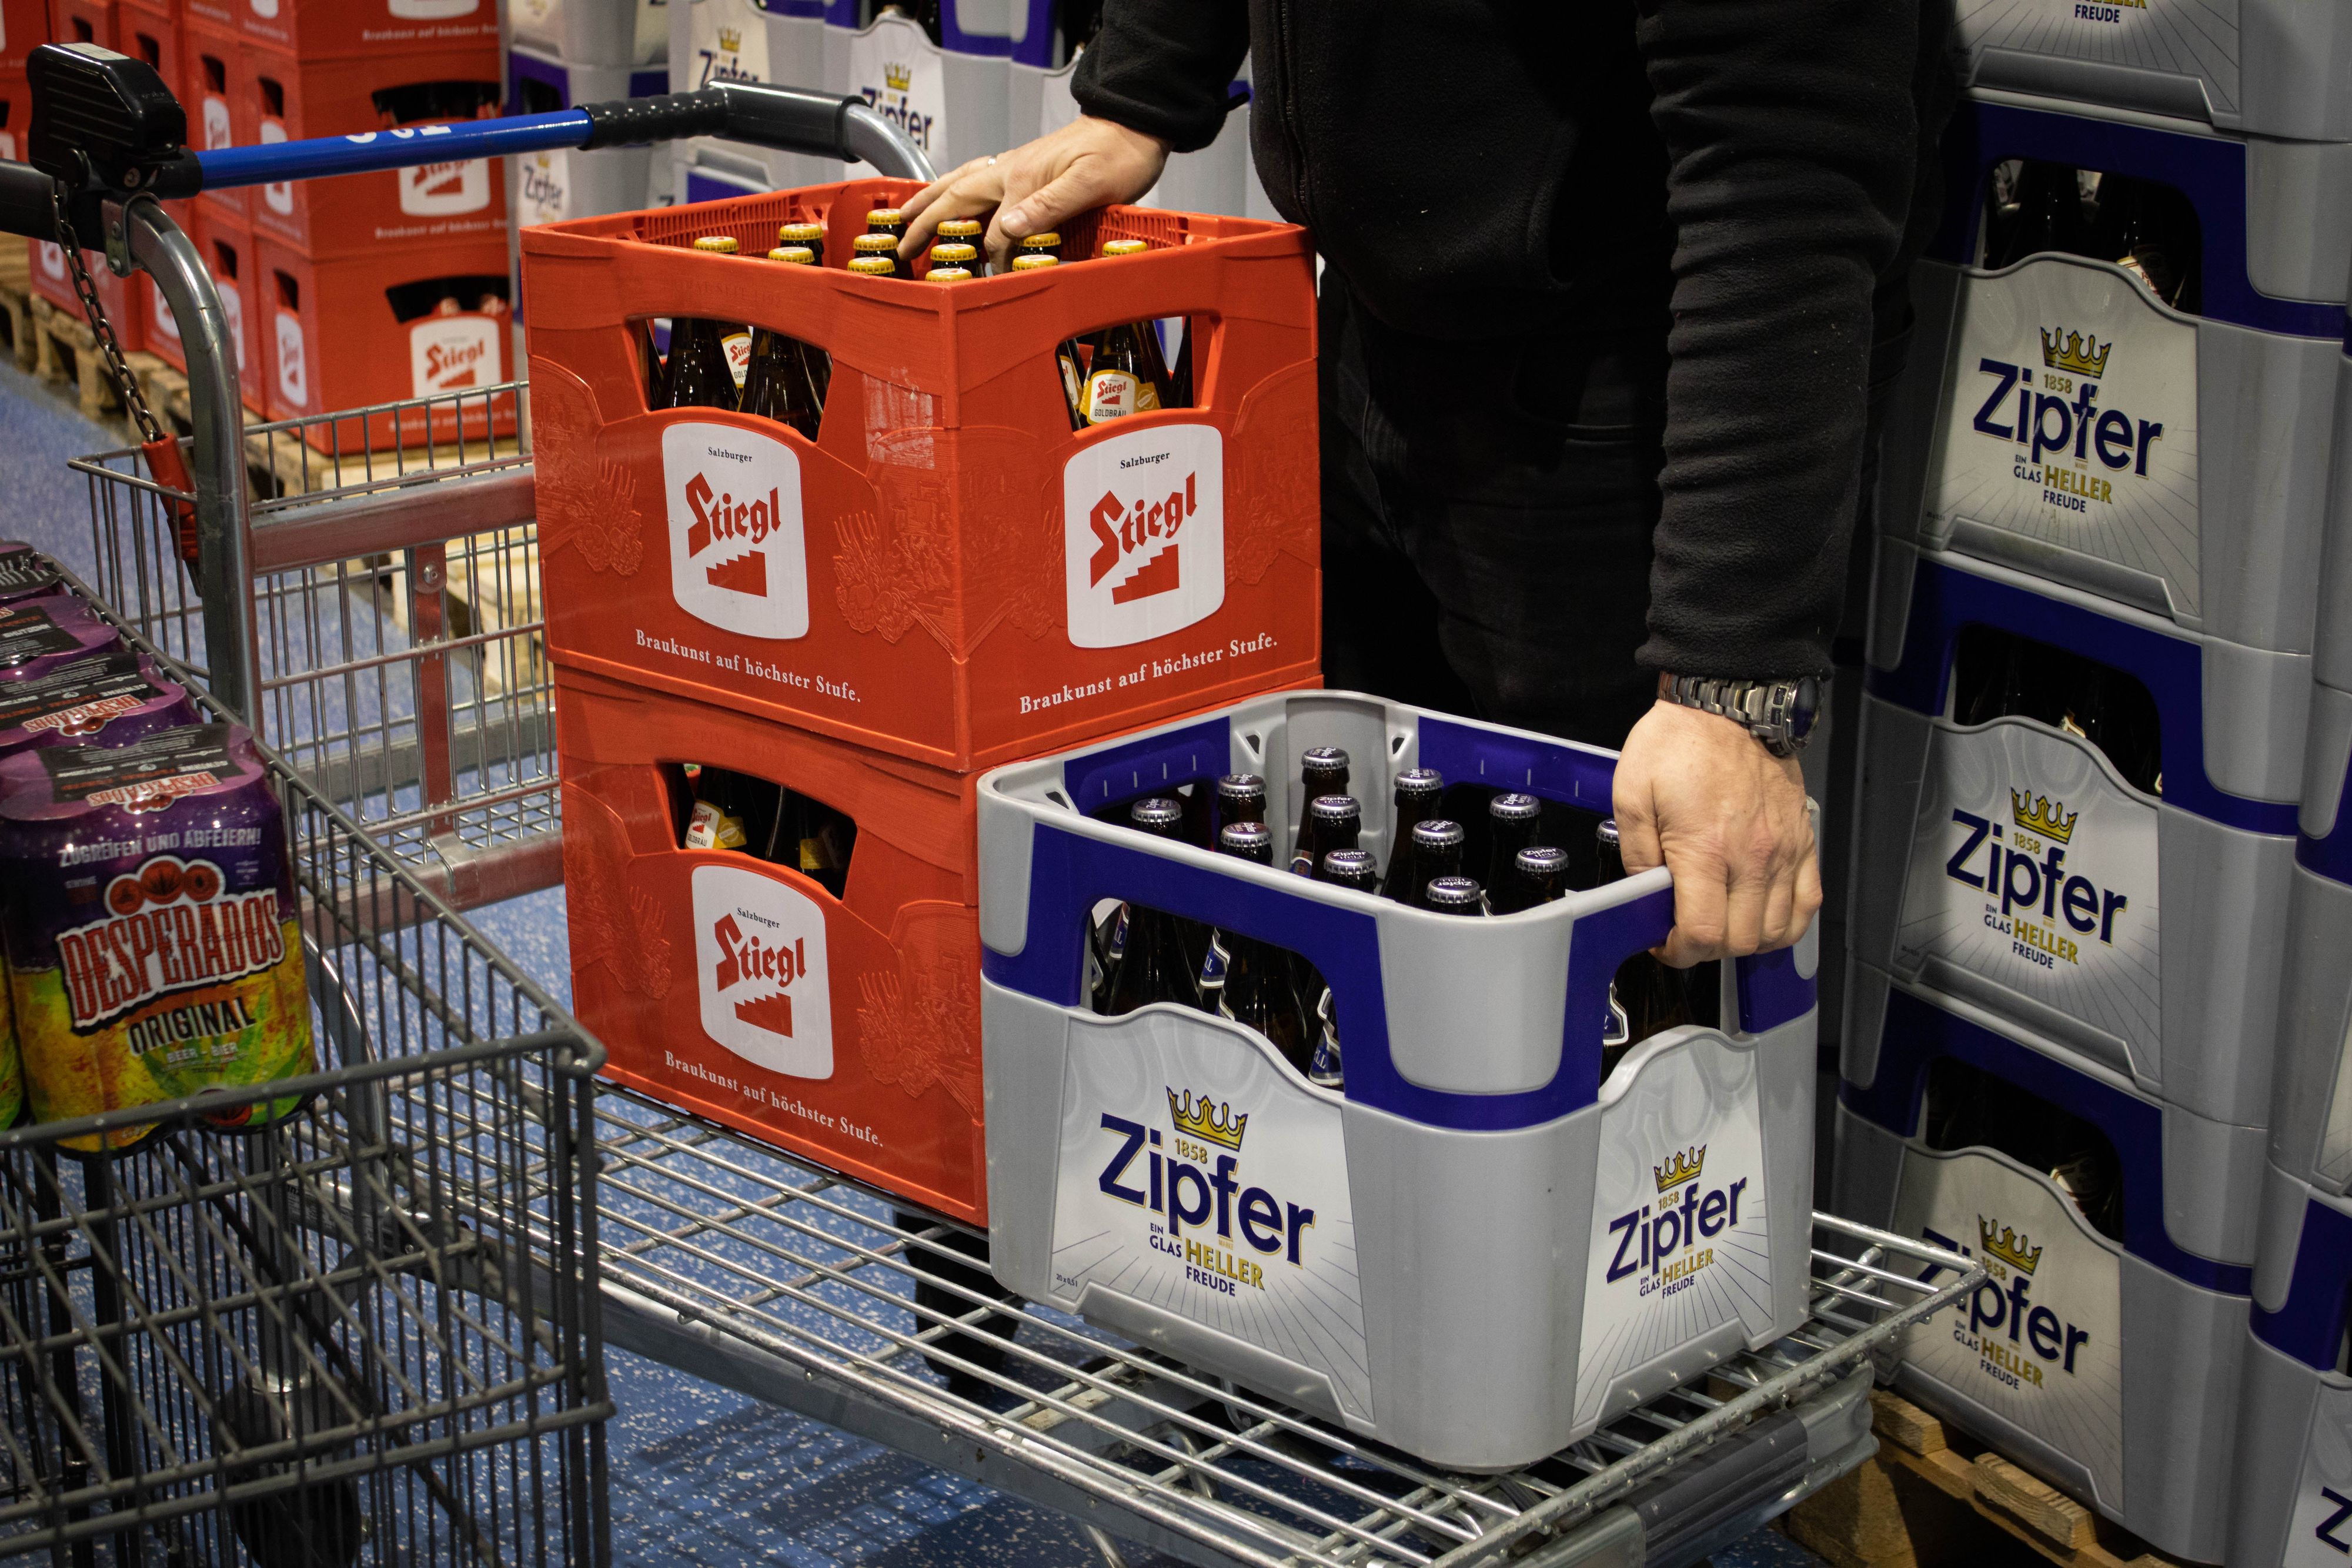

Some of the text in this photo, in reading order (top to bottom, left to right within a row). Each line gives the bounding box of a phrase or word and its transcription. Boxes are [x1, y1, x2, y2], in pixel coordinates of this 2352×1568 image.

[2074, 5, 2120, 24] FREUDE
[1097, 380, 1127, 399] Stiegl
[2043, 374, 2073, 394] 1858
[1973, 359, 2165, 479] Zipfer
[707, 447, 753, 463] Salzburger
[1120, 451, 1171, 470] Salzburger
[2014, 454, 2027, 465] EIN
[2013, 464, 2112, 504] GLAS HELLER
[685, 471, 781, 559] Stiegl
[2043, 490, 2087, 513] FREUDE
[1089, 470, 1197, 590] Stiegl
[635, 629, 861, 703] Braukunst auf höchster Stufe.
[1019, 633, 1278, 714] Braukunst auf höchster Stufe.
[22, 695, 146, 733] DESPERADOS
[86, 772, 221, 806] DESPERADOS
[59, 828, 262, 867] ZUGREIFEN UND ABFEIERN!
[1524, 848, 1558, 856] Zipfer
[2013, 832, 2041, 855] 1858
[1946, 808, 2127, 948] Zipfer
[736, 907, 781, 930] Salzburger
[1985, 904, 1997, 915] EIN
[714, 912, 807, 993] Stiegl
[1984, 914, 2079, 965] GLAS HELLER
[2012, 941, 2054, 969] FREUDE
[60, 895, 283, 1021] DESPERADOS
[128, 997, 256, 1056] ORIGINAL
[167, 1048, 198, 1064] BEER
[211, 1042, 238, 1057] BIER
[664, 1050, 884, 1148] Braukunst auf höchster Stufe.
[1174, 1138, 1209, 1165] 1858
[1098, 1112, 1316, 1269] Zipfer
[1658, 1191, 1680, 1211] 1858
[1150, 1222, 1164, 1236] EIN
[1606, 1176, 1747, 1285] Zipfer
[1149, 1235, 1265, 1292] GLAS HELLER
[1639, 1248, 1715, 1298] GLAS HELLER
[1982, 1256, 2007, 1281] 1858
[1186, 1265, 1237, 1298] FREUDE
[1639, 1275, 1649, 1286] EIN
[1662, 1275, 1695, 1299] FREUDE
[1953, 1329, 2043, 1390] GLAS HELLER
[1980, 1359, 2020, 1390] FREUDE
